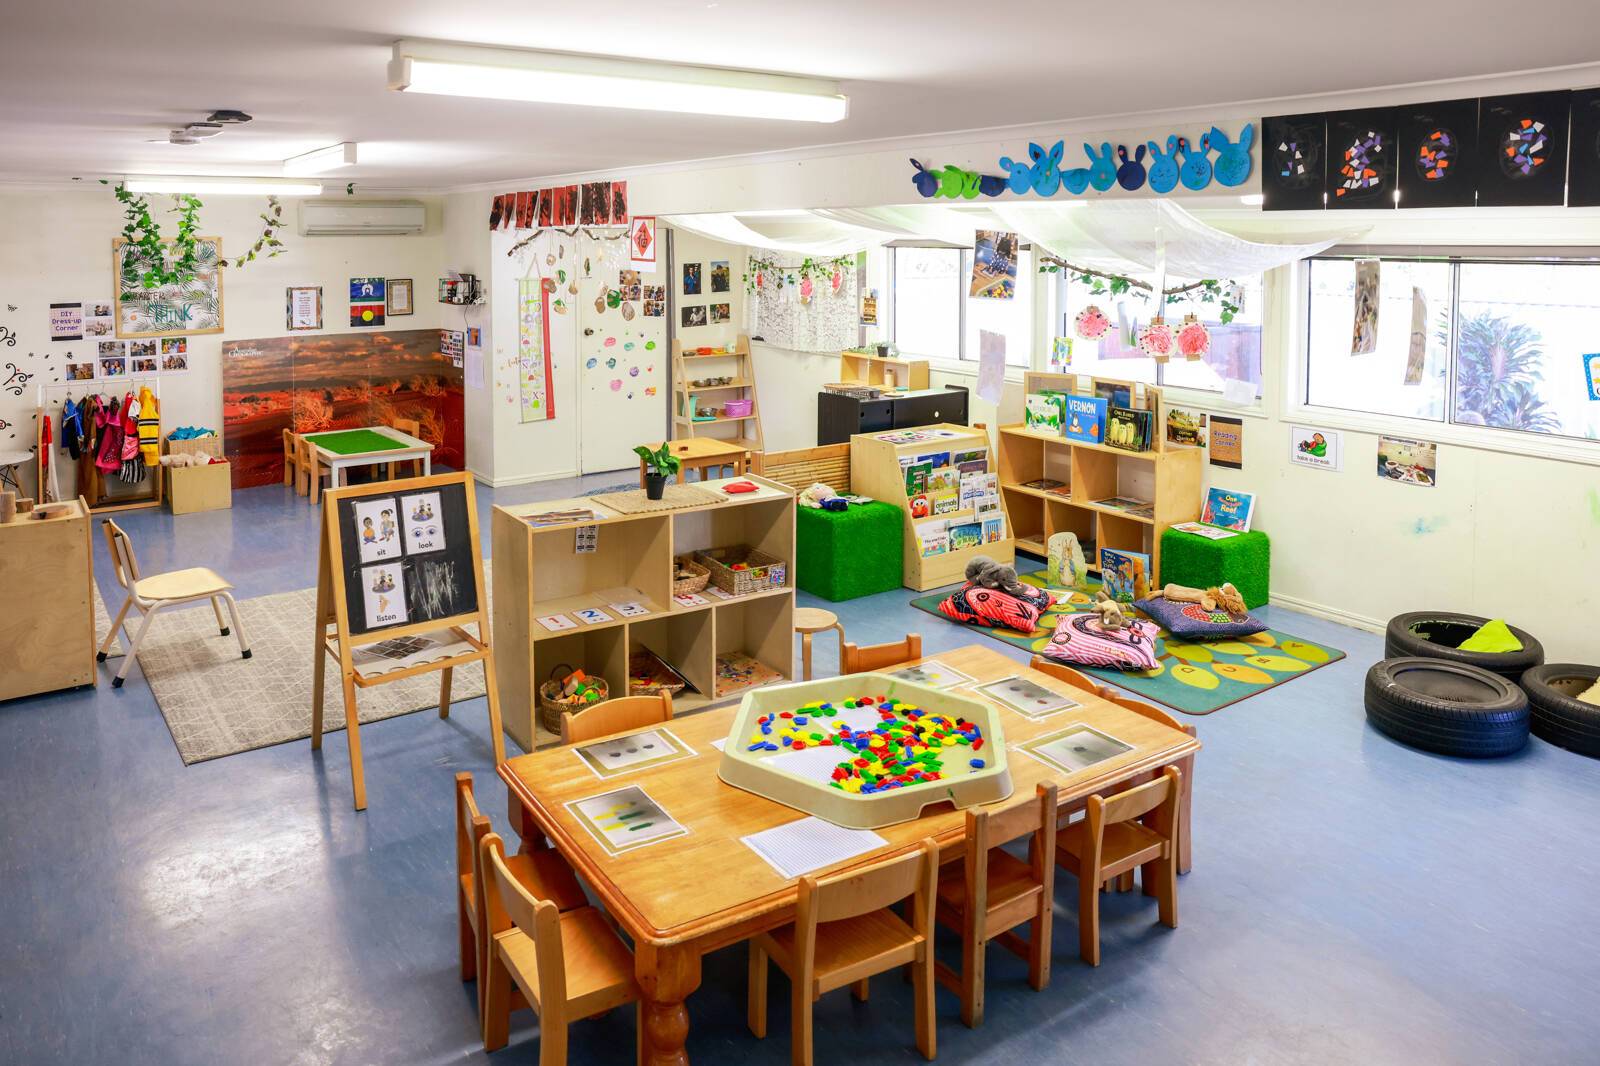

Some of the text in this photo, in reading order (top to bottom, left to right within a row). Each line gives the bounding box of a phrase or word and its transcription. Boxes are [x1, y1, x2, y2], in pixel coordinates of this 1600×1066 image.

[1068, 399, 1097, 415] VERNON
[1214, 430, 1238, 441] Reading
[935, 499, 957, 509] animals
[1220, 504, 1237, 514] Reef
[418, 540, 433, 549] look
[376, 548, 386, 556] sit
[376, 613, 397, 622] listen
[582, 610, 600, 619] 2
